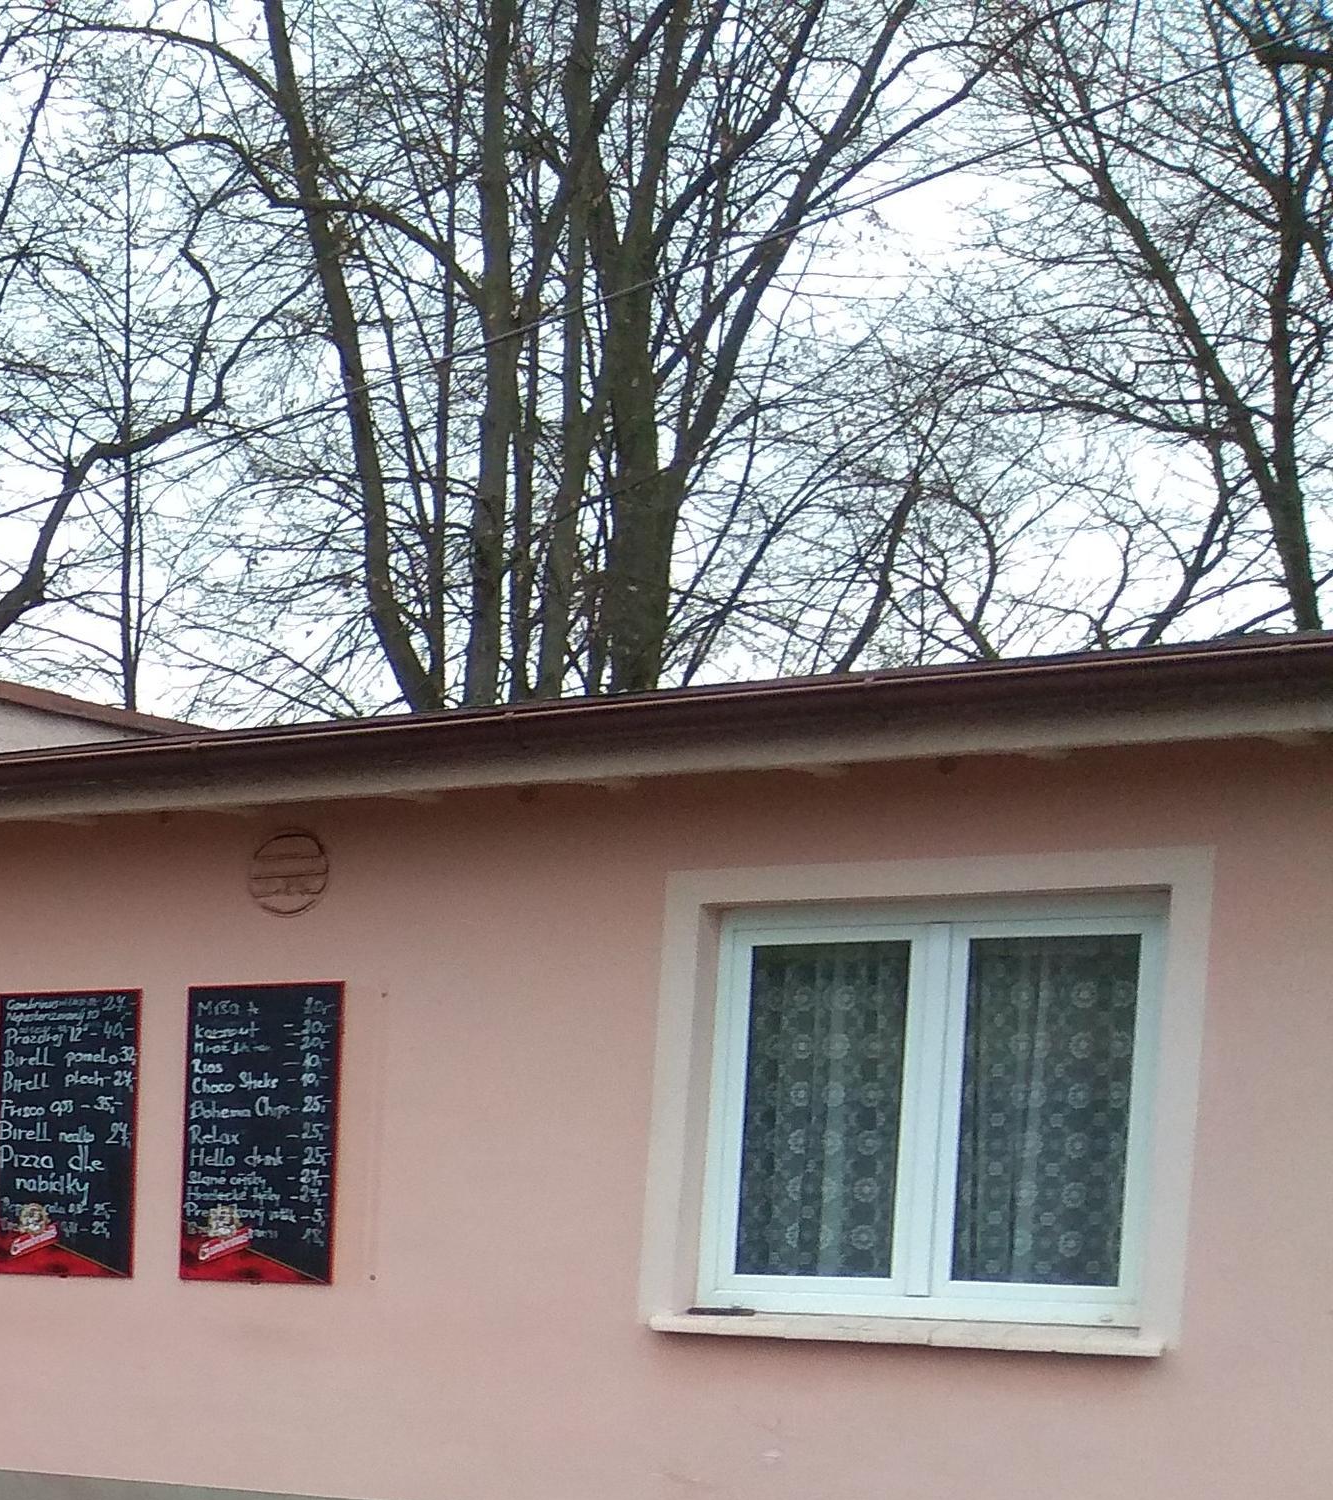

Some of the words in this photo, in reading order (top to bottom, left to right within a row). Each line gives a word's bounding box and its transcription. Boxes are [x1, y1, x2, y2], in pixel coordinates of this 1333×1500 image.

[4, 1027, 64, 1048] Prazdroj
[2, 1046, 55, 1068] Birell
[191, 1076, 236, 1095] Choco
[0, 1099, 45, 1119] Frisco
[188, 1124, 241, 1145] Relax
[67, 1144, 106, 1173] dle
[189, 1148, 236, 1167] Hello
[15, 1172, 90, 1206] nabídky
